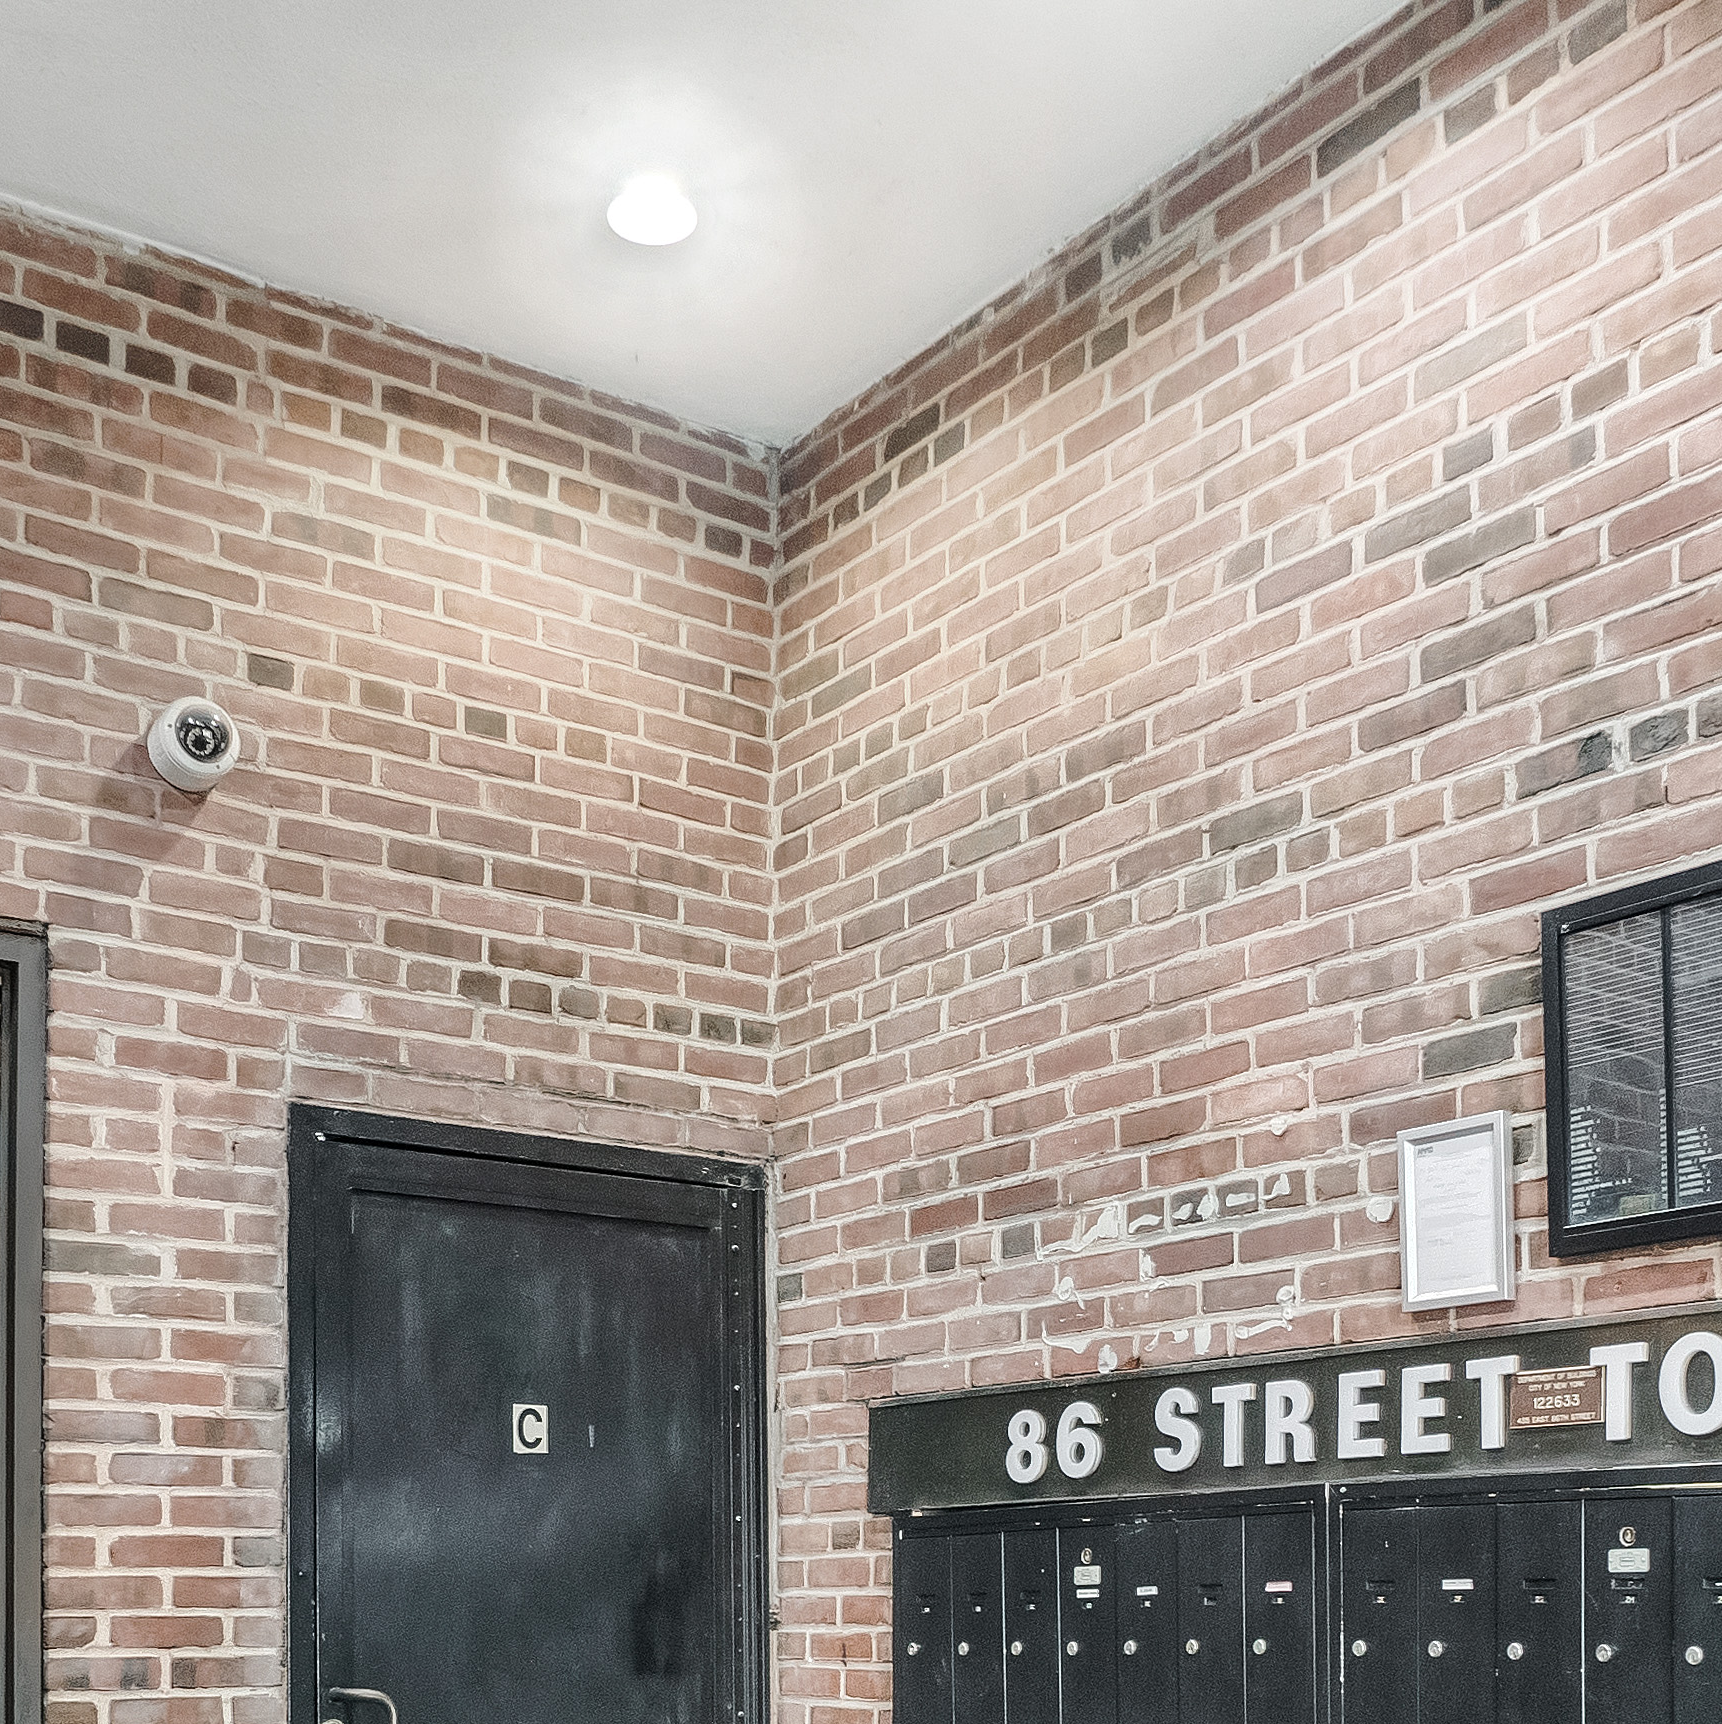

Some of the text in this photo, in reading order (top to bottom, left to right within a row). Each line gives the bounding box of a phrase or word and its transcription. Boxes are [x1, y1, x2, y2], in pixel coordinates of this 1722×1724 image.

[1528, 1384, 1542, 1392] CITY
[1553, 1382, 1568, 1390] NEW
[1533, 1394, 1581, 1409] 122633
[1005, 1401, 1105, 1485] 86
[1154, 1355, 1521, 1473] STREET
[1532, 1415, 1549, 1423] EAST
[1571, 1411, 1596, 1420] STREET
[518, 1408, 543, 1449] C
